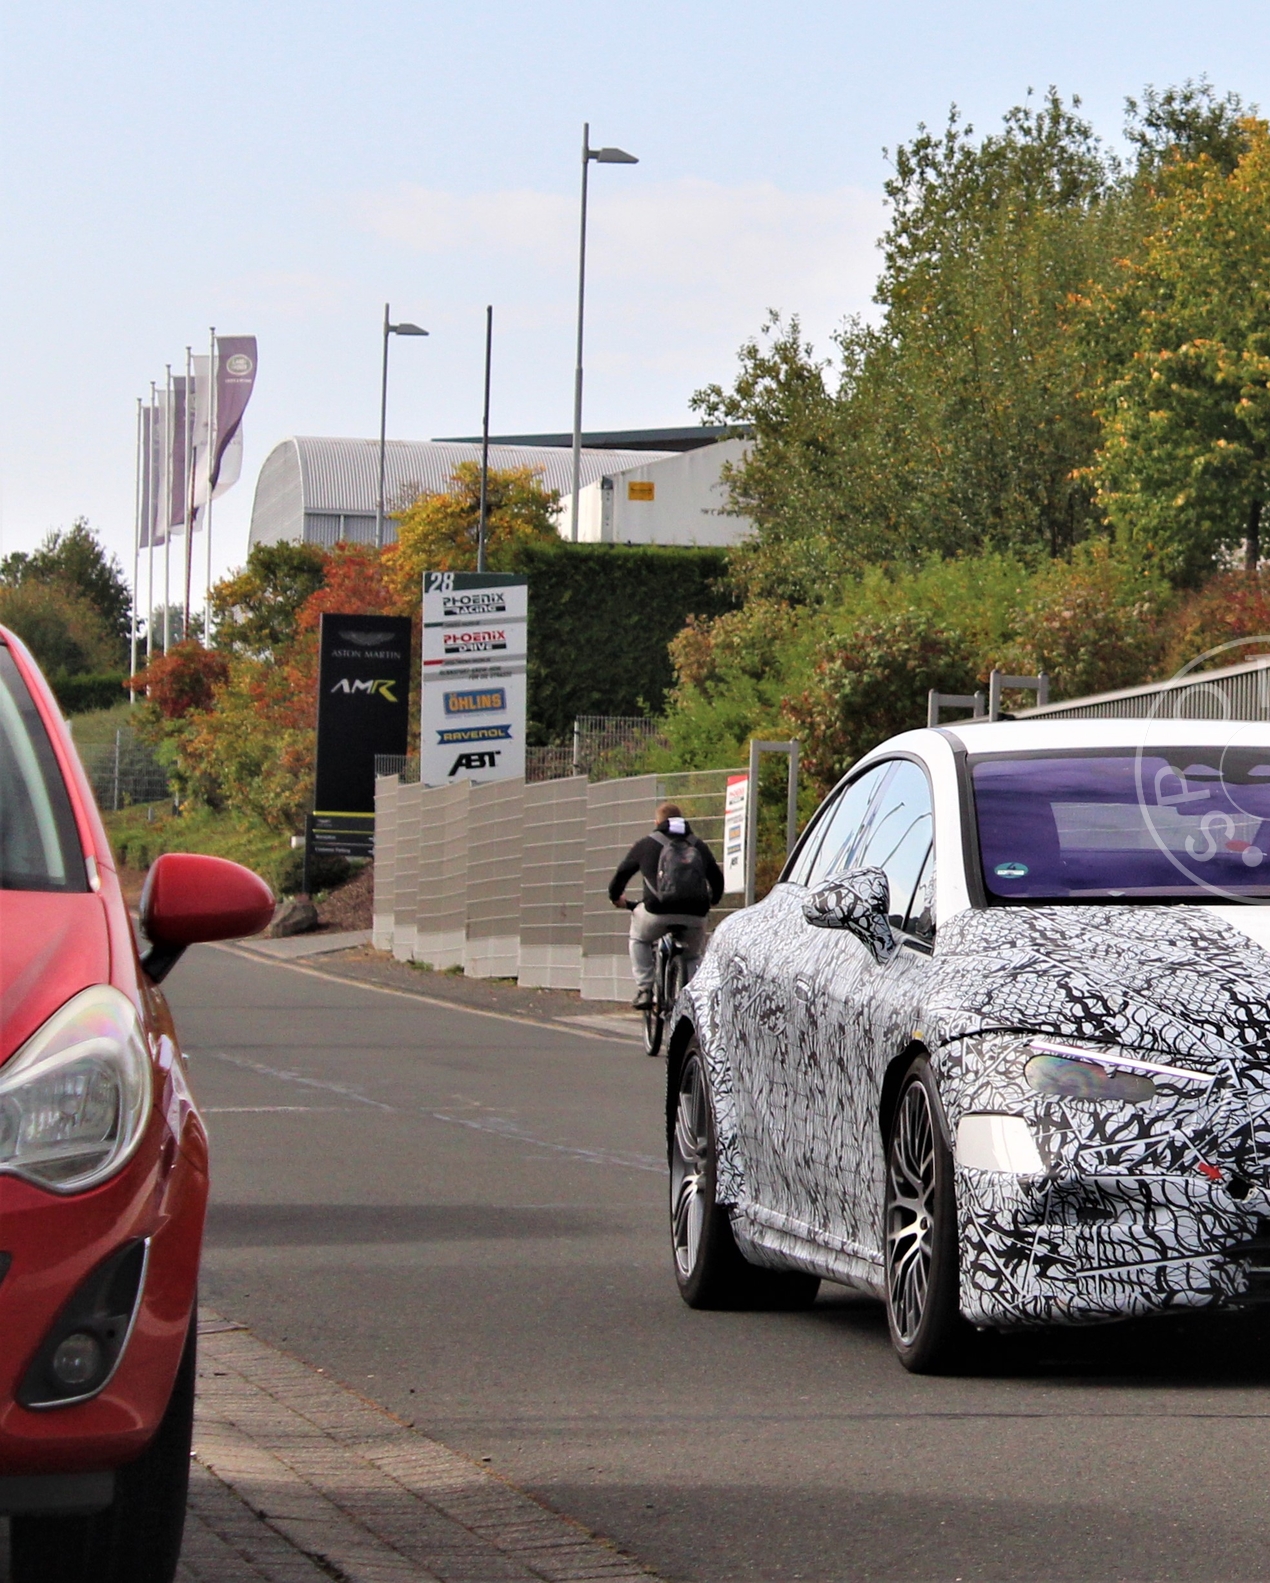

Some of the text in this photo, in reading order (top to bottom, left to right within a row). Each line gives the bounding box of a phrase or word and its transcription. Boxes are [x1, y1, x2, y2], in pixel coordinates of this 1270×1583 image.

[428, 572, 454, 593] 28
[443, 593, 505, 606] PHOENIX
[443, 630, 506, 644] PHOENIX
[331, 649, 402, 660] ASTON MARTIN
[330, 678, 398, 702] AMR
[449, 692, 502, 711] ÖHLINS
[443, 729, 506, 741] RAVENOL
[448, 749, 501, 777] ABT
